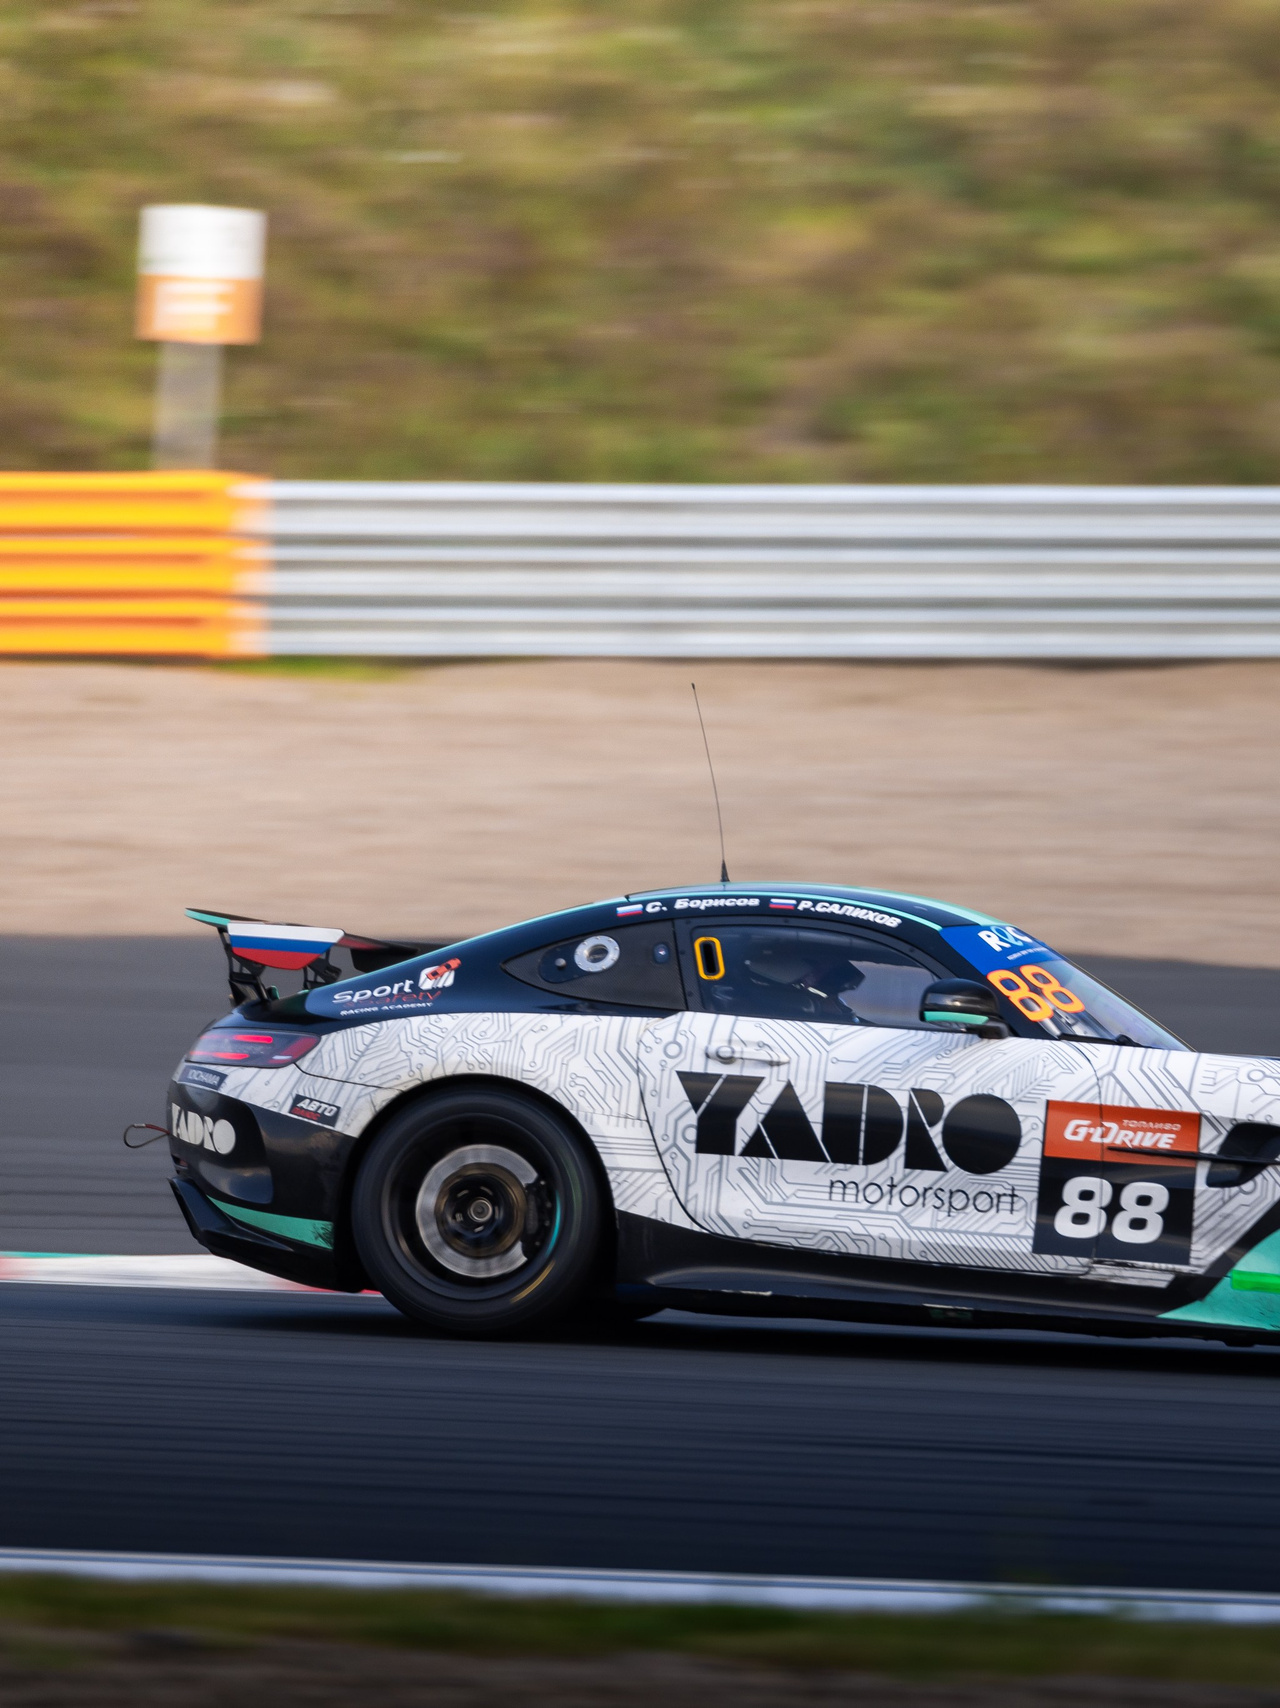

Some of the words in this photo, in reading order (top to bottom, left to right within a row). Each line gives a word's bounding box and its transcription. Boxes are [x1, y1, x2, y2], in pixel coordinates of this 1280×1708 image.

[645, 901, 668, 913] С.
[674, 898, 760, 911] Борисов
[797, 900, 903, 928] Р.САЛИХОВ
[340, 1006, 379, 1016] RACING
[381, 1002, 434, 1011] ACADEMY
[986, 964, 1086, 1022] 88
[296, 1098, 338, 1117] АВТО
[675, 1070, 1022, 1175] YADRO
[828, 1176, 1019, 1217] motorsport
[1054, 1176, 1170, 1244] 88
